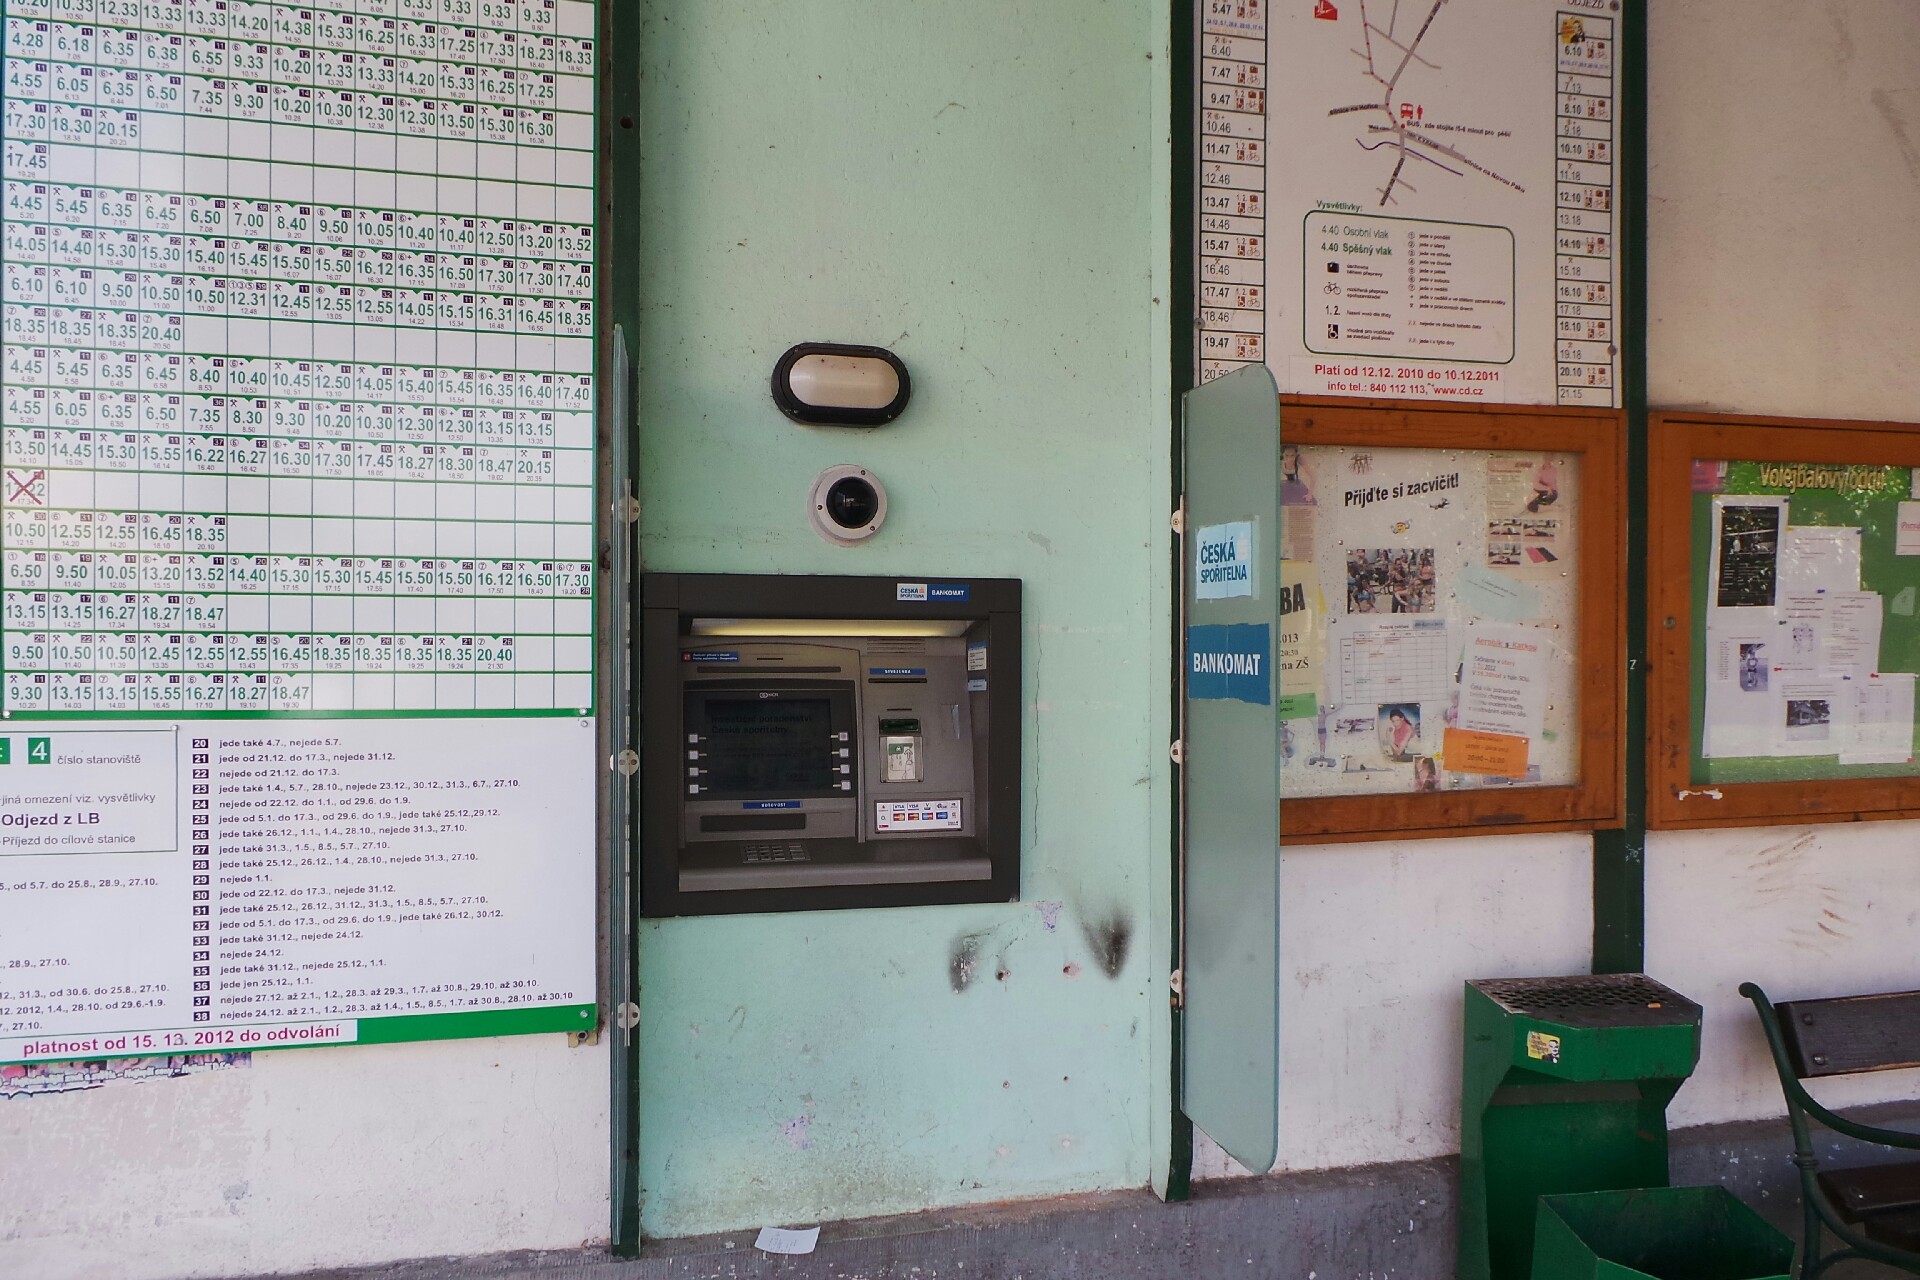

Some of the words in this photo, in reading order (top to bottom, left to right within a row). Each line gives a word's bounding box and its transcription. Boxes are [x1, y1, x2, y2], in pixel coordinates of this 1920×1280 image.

[1213, 4, 1231, 14] 5.47
[1212, 46, 1230, 56] 6.40
[12, 31, 47, 48] 4.28
[57, 34, 92, 51] 6.18
[104, 38, 137, 55] 6.35
[148, 42, 181, 59] 6.38
[193, 47, 225, 64] 6.55
[235, 51, 267, 69] 9.33
[274, 56, 310, 73] 10.20
[317, 60, 353, 77] 12.33
[358, 64, 394, 81] 13.33
[399, 71, 434, 88] 14.20
[440, 74, 475, 91] 15.33
[480, 78, 514, 95] 16.25
[520, 82, 553, 100] 17.25
[1212, 67, 1230, 77] 7.47
[1211, 93, 1230, 104] 9.47
[1205, 122, 1230, 134] 10.46
[1206, 143, 1230, 154] 11.47
[1205, 197, 1229, 208] 13.47
[1316, 200, 1363, 212] Vysvětlivky:
[1321, 225, 1338, 235] 4.40
[1343, 226, 1371, 236] Osobní
[1373, 230, 1388, 238] vlak
[1205, 240, 1229, 250] 15.47
[1321, 242, 1338, 251] 4.40
[1343, 243, 1373, 255] Spěšný
[1375, 246, 1391, 255] vlak
[1205, 287, 1229, 297] 17.47
[1326, 305, 1331, 314] 1.
[1334, 305, 1340, 315] 2.
[1205, 337, 1229, 347] 19.47
[1343, 366, 1357, 375] od
[1362, 367, 1393, 377] 12.12.
[1397, 368, 1423, 378] 2010
[1427, 370, 1440, 379] do
[1445, 370, 1498, 380] 10.12.2011
[1328, 381, 1346, 390] info
[1349, 383, 1366, 391] tel.:
[1370, 383, 1386, 392] 840
[1390, 384, 1405, 393] 112
[1409, 384, 1428, 394] 113,
[1433, 385, 1484, 395] www.cd.cz
[1345, 488, 1388, 508] Přijďte
[1393, 483, 1403, 498] si
[1408, 473, 1459, 495] zacvičit!
[1201, 537, 1235, 564] ČESKÁ
[11, 563, 41, 580] 6.50
[57, 563, 87, 580] 9.50
[98, 563, 136, 581] 10.05
[142, 564, 180, 581] 13.20
[186, 564, 224, 581] 13.52
[230, 566, 266, 583] 14.40
[272, 566, 309, 584] 15.30
[315, 567, 350, 584] 15.30
[356, 567, 395, 584] 15.45
[398, 567, 433, 584] 15.50
[438, 567, 473, 584] 15.50
[478, 568, 515, 585] 16.12
[518, 569, 554, 586] 16.50
[557, 570, 588, 587] 17.30
[1201, 565, 1247, 583] SPOŘITELNA
[1194, 653, 1260, 675] BANKOMAT
[1296, 657, 1308, 669] ZŠ
[12, 685, 42, 702] 9.30
[52, 685, 91, 702] 13.15
[98, 685, 136, 702] 13.15
[143, 685, 180, 702] 15.55
[186, 684, 223, 701] 16.27
[230, 684, 266, 701] 18.27
[272, 684, 309, 701] 18.47
[219, 740, 239, 748] jede
[289, 739, 321, 747] nejede
[32, 742, 47, 760] 4
[57, 755, 82, 764] číslo
[86, 755, 140, 763] stanoviště
[219, 754, 239, 764] jede
[242, 754, 255, 762] od
[258, 754, 286, 762] 21.12.
[290, 754, 302, 762] do
[306, 754, 330, 762] 17.3.,
[334, 752, 364, 763] nejede
[368, 752, 395, 761] 31.12.
[0, 795, 20, 806] -jiná
[24, 794, 72, 803] omezení
[98, 793, 155, 804] vysvětlivky
[1, 813, 57, 828] Odjezd
[63, 816, 71, 824] z
[78, 813, 99, 824] LB
[0, 836, 40, 847] -Příjezd
[44, 836, 57, 844] do
[61, 835, 93, 844] cílové
[97, 835, 135, 843] stanice
[220, 875, 252, 884] nejede
[24, 1039, 98, 1056] platnost
[104, 1036, 125, 1049] od
[133, 1035, 156, 1047] 15.
[194, 1030, 233, 1044] 2012
[240, 1029, 260, 1041] do
[267, 1024, 339, 1039] odvolání
